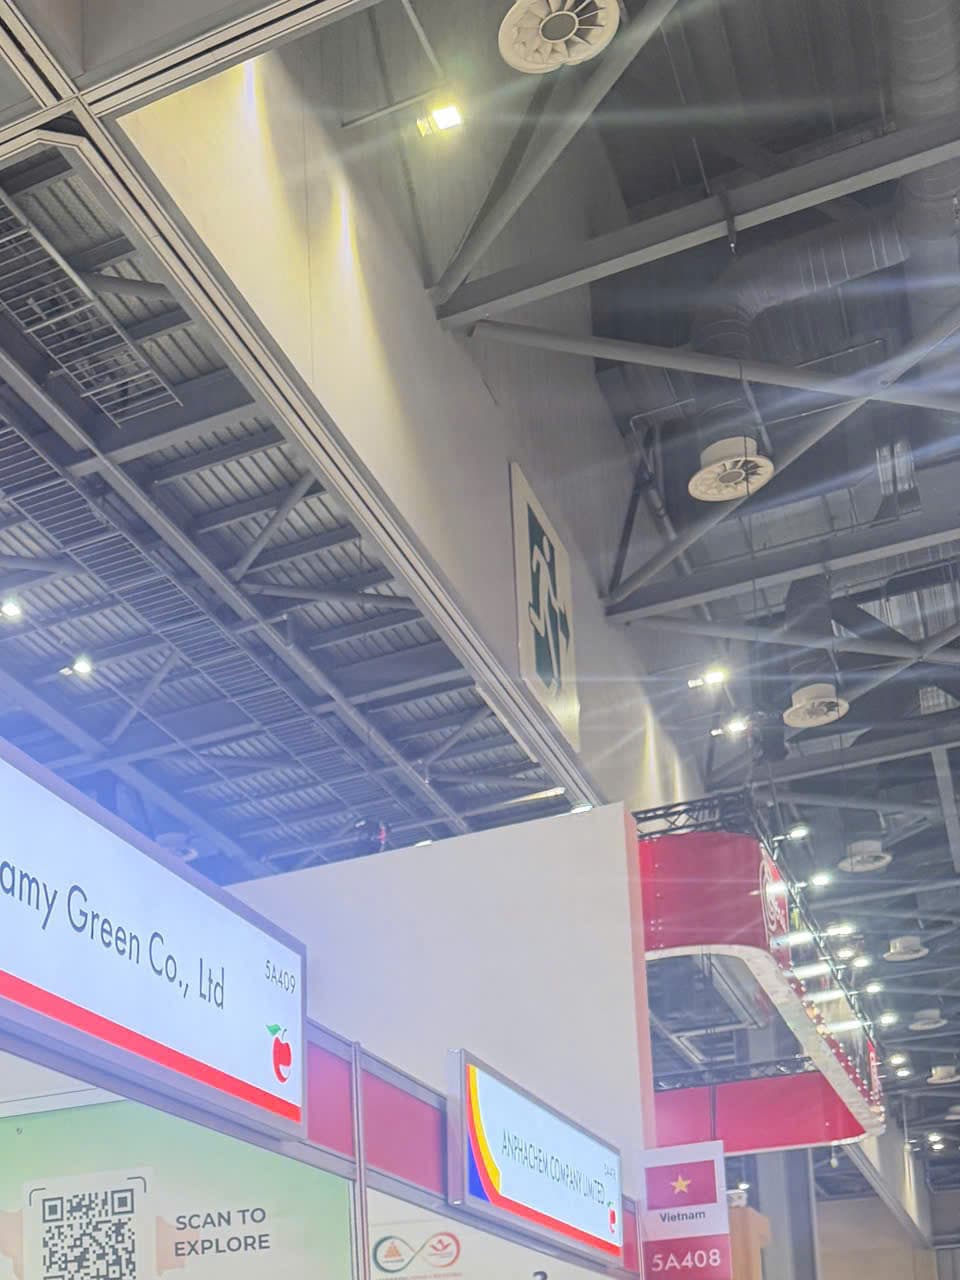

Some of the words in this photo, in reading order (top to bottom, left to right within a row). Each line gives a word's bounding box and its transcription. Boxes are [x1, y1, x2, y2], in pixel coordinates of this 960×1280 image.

[67, 885, 140, 964] Green
[149, 931, 189, 999] Co.,
[199, 957, 225, 1010] Ltd
[265, 959, 296, 994] 5A409
[550, 1155, 581, 1192] COMPANY
[583, 1176, 606, 1205] LIMITED
[176, 1210, 231, 1231] SCAN
[237, 1208, 267, 1224] TO
[659, 1209, 706, 1223] Vietnam
[174, 1234, 270, 1257] EXPLORE
[651, 1249, 721, 1272] 5A408
